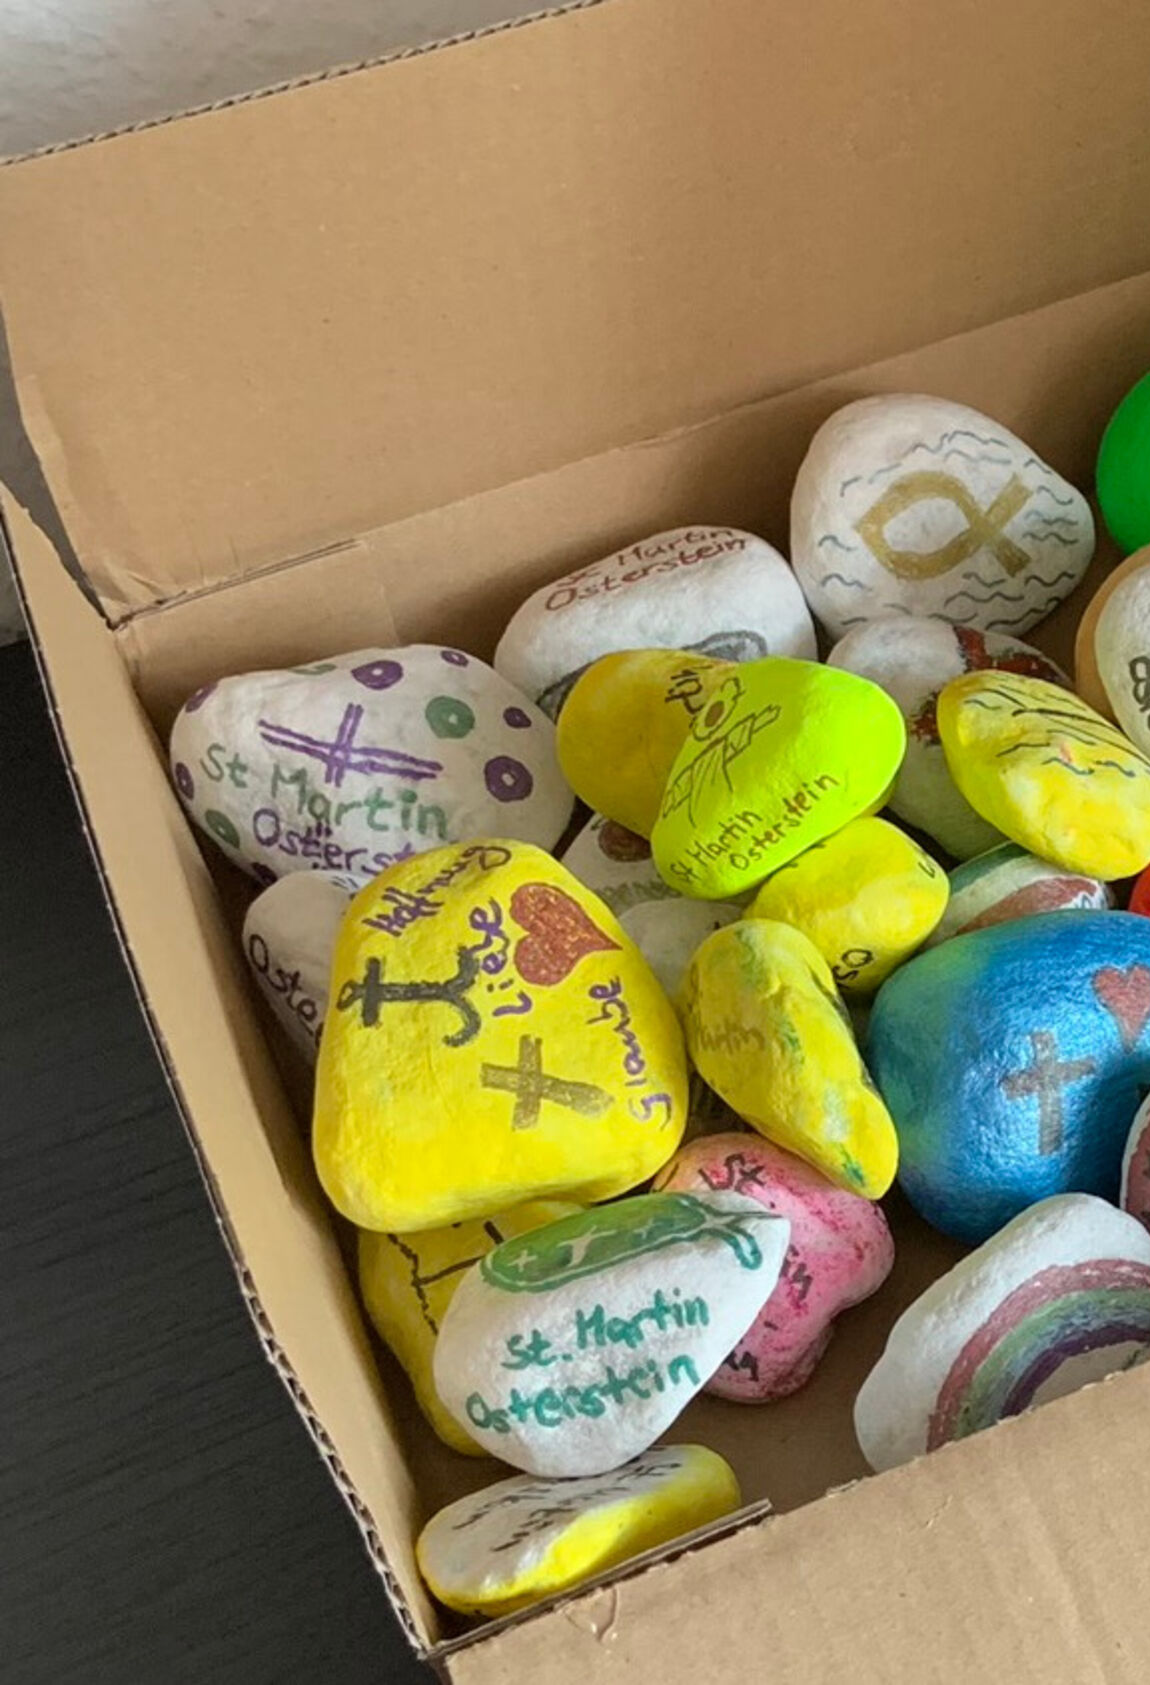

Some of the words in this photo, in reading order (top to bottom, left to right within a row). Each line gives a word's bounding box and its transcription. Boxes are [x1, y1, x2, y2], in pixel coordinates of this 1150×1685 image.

[545, 538, 747, 611] Osterstein
[201, 743, 248, 788] St
[271, 763, 449, 841] Martin
[729, 772, 840, 871] Osterstein
[685, 810, 763, 867] Martin
[586, 974, 673, 1132] Glaube
[502, 1328, 572, 1371] St.
[575, 1287, 711, 1350] Martin
[464, 1353, 700, 1434] Osterstein
